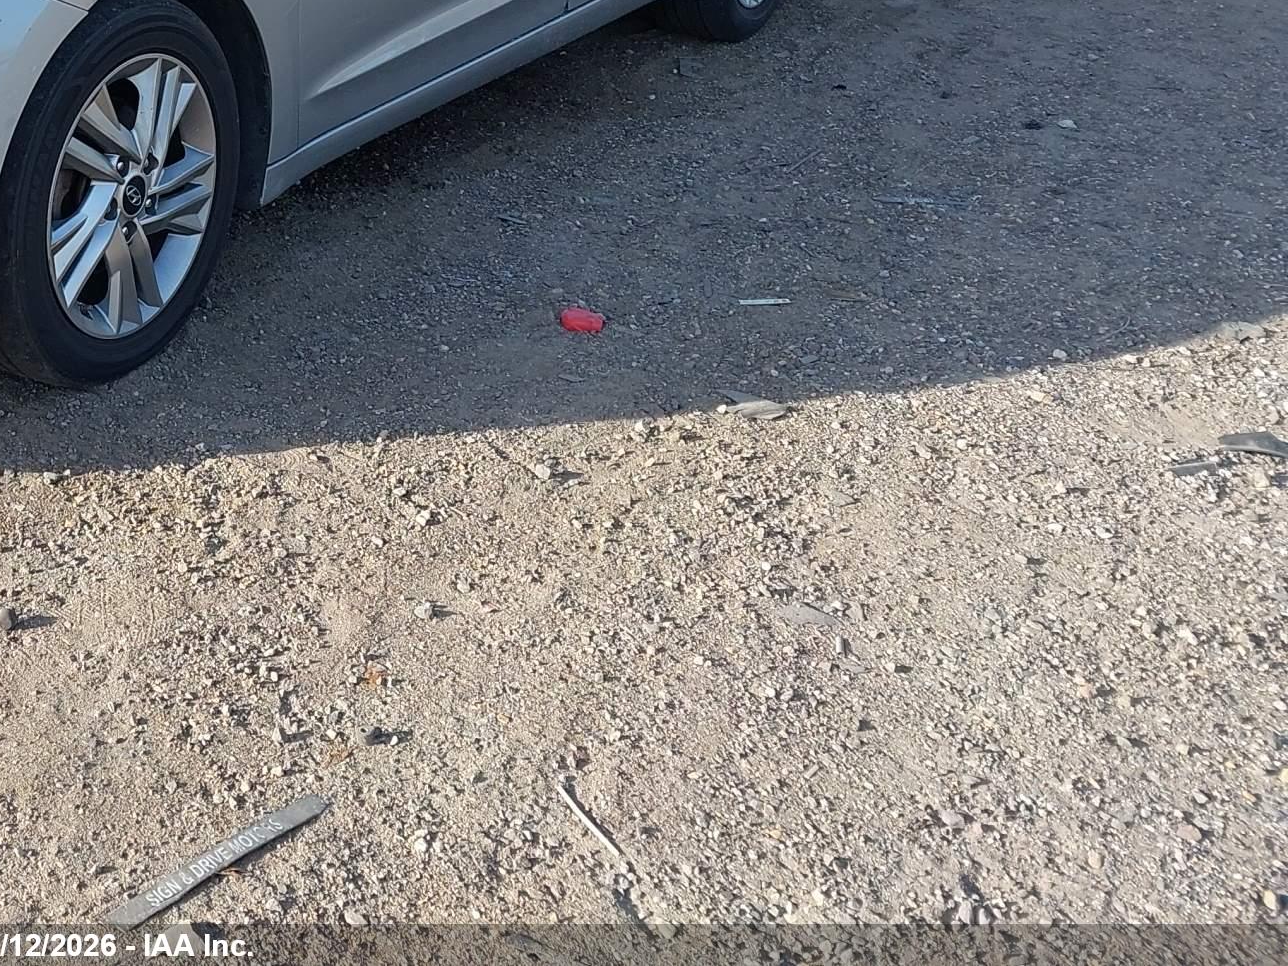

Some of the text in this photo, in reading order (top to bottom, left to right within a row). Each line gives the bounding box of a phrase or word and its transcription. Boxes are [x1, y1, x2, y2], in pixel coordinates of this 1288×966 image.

[146, 880, 182, 907] SIGN
[179, 871, 193, 886] &
[190, 846, 234, 879] DRIVE
